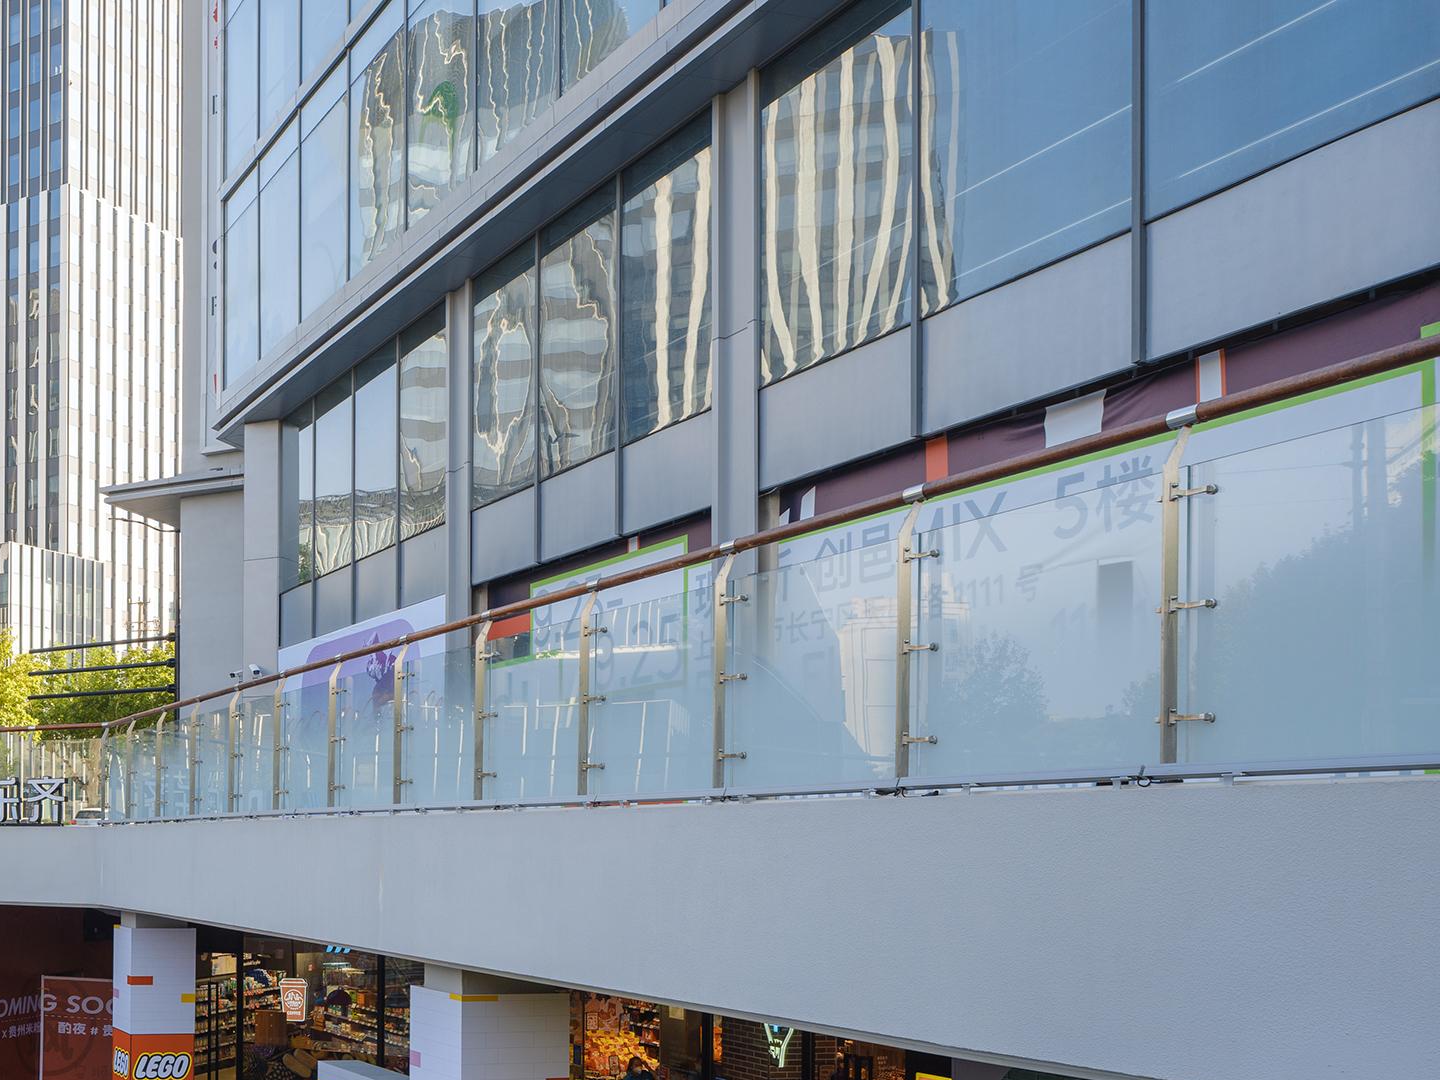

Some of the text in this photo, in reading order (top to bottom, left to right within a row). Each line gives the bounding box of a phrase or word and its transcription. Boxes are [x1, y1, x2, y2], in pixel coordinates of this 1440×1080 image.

[1053, 455, 1155, 540] 5楼
[113, 1047, 130, 1079] LEGO
[133, 1053, 191, 1080] LEGO
